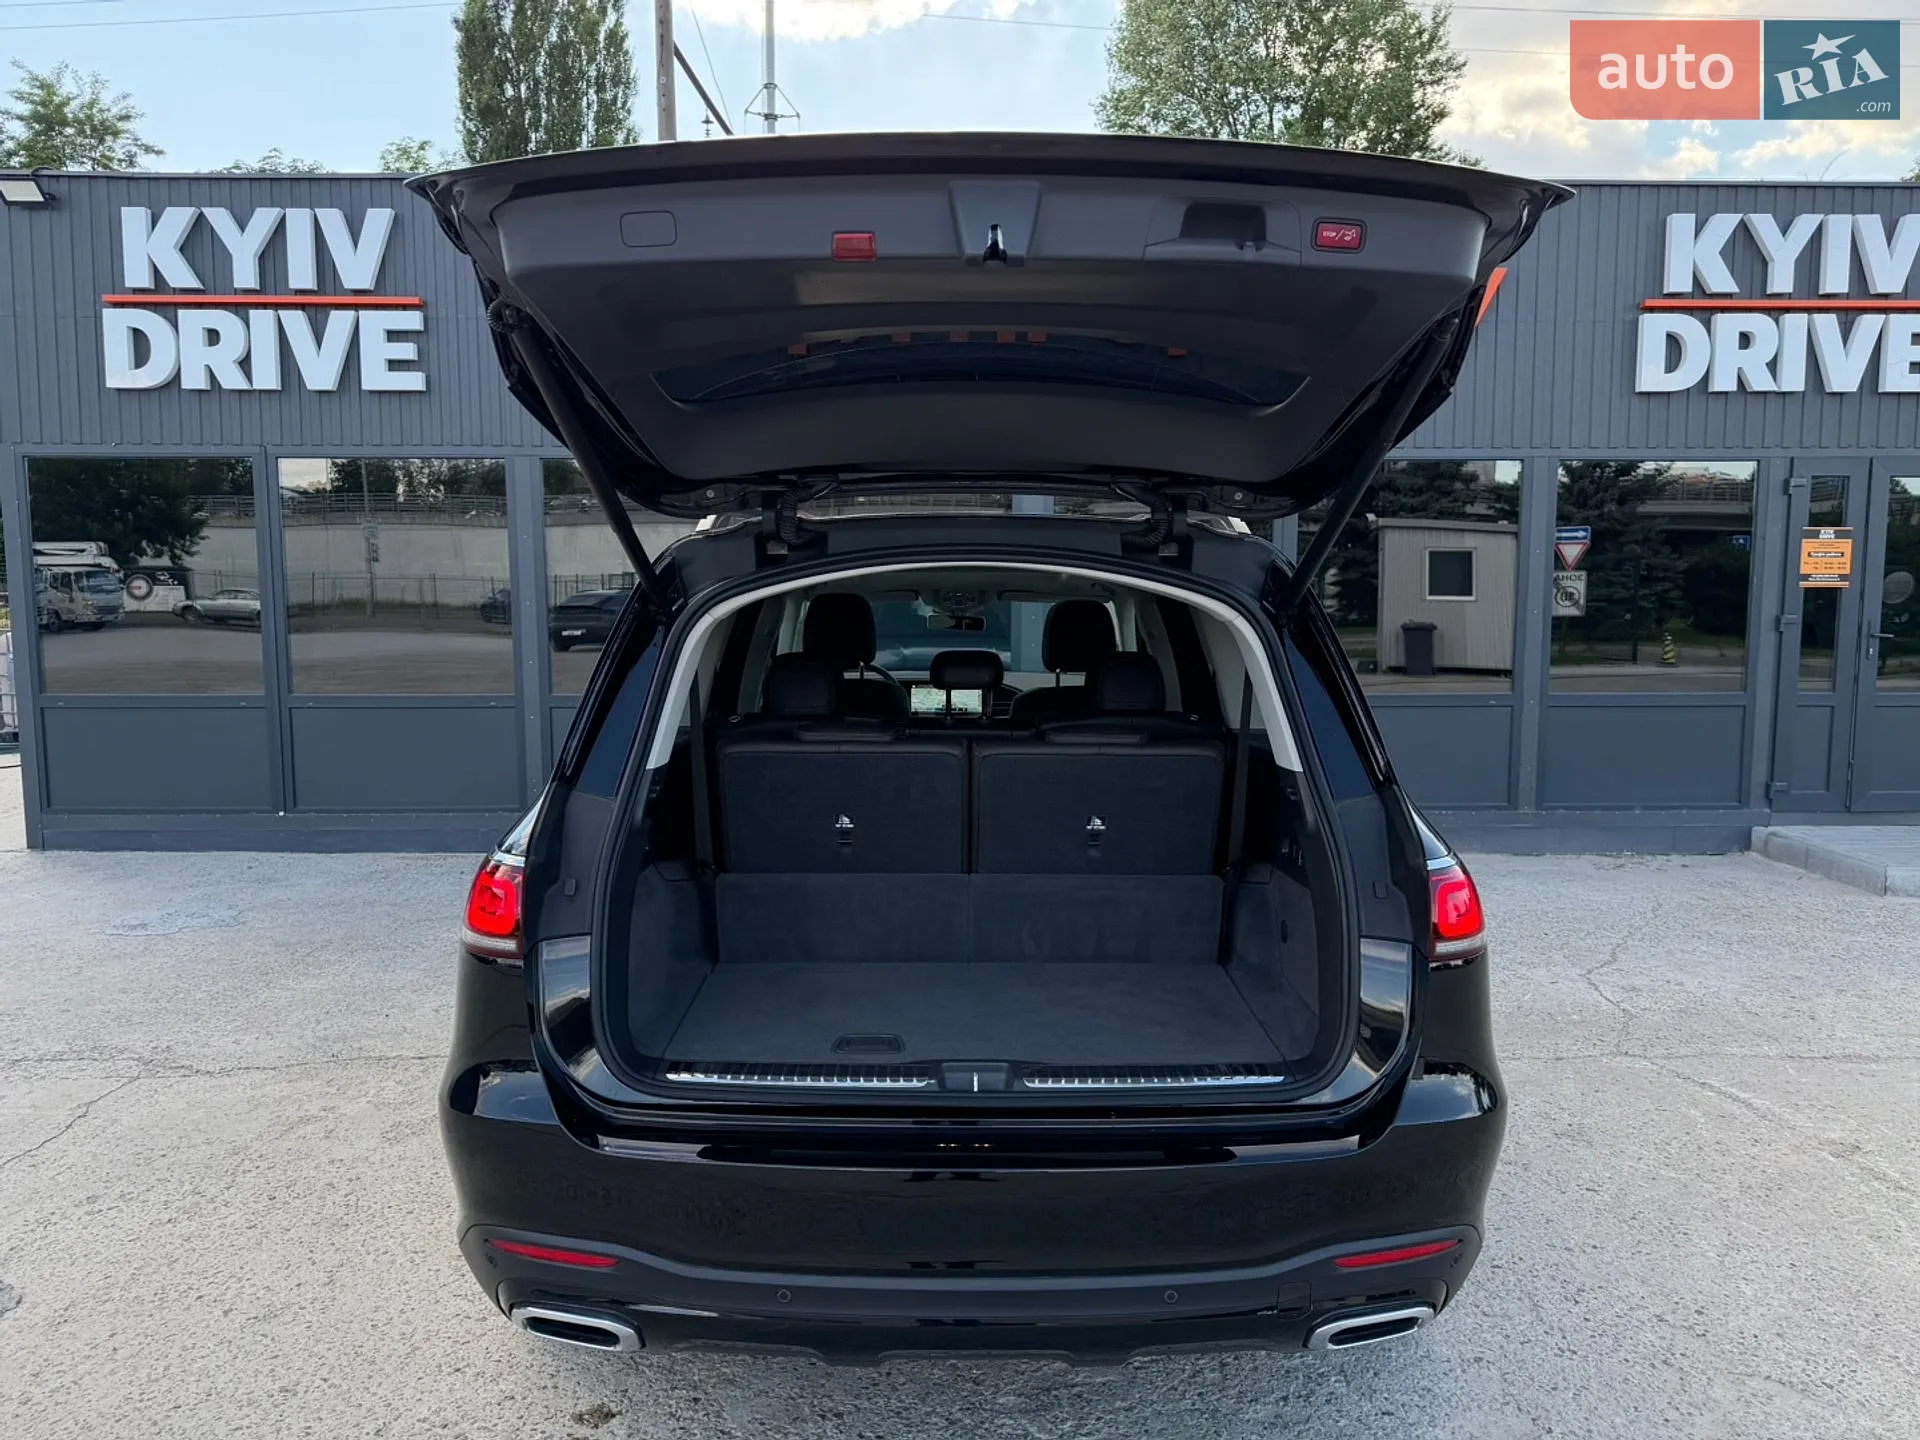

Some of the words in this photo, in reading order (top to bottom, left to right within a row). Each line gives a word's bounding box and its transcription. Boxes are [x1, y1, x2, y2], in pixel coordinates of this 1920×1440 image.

[121, 206, 396, 291] KYIV
[1663, 213, 1920, 294] KYIV
[102, 308, 427, 392] DRIVE
[1635, 313, 1920, 393] DRIVE
